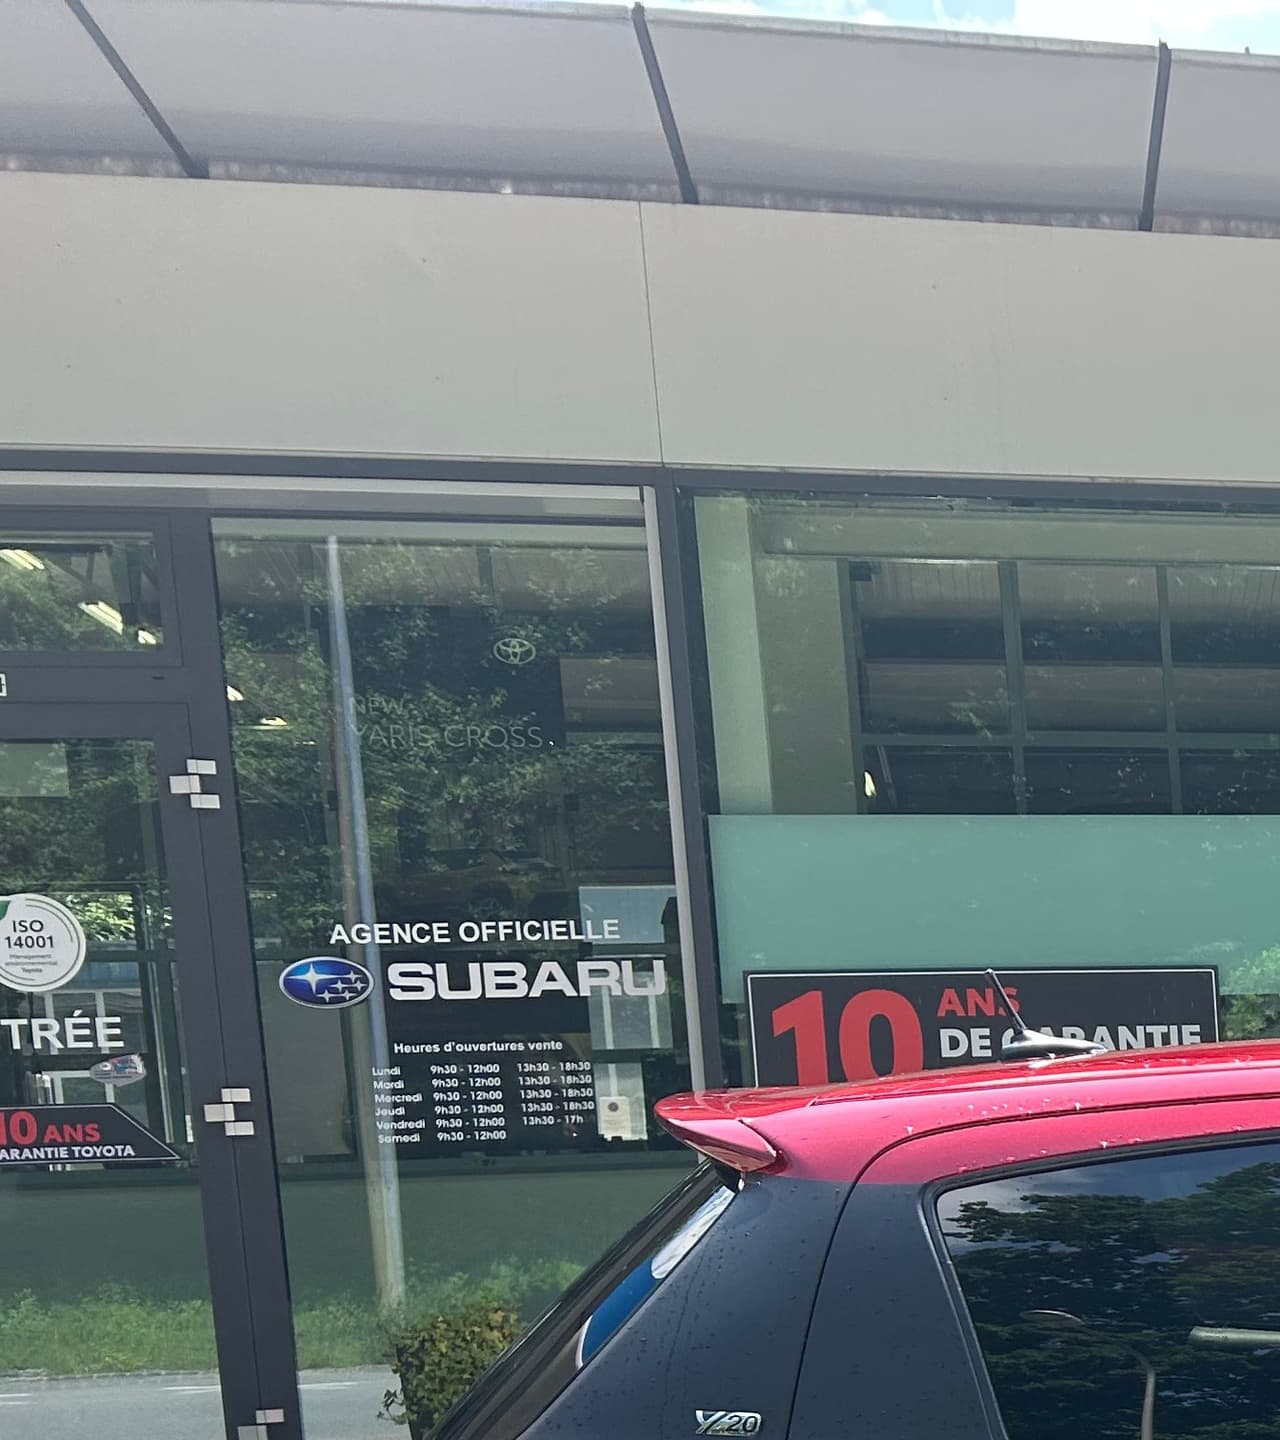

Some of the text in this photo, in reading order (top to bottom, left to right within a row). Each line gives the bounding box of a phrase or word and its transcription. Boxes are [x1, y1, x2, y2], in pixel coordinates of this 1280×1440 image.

[350, 723, 543, 748] YARIS CROSS
[12, 920, 44, 933] ISO
[329, 919, 621, 944] AGENCE OFFICIELLE
[5, 935, 54, 949] 14001
[387, 959, 666, 1000] SUBARU
[772, 989, 924, 1086] 10
[940, 1027, 992, 1058] DE
[394, 1041, 563, 1054] Heures d'ouvertures vente
[372, 1066, 400, 1076] Lundi
[430, 1064, 457, 1074] 9h30
[467, 1064, 500, 1073] 12h00
[517, 1063, 549, 1073] 13h30
[559, 1062, 591, 1071] 18h30
[373, 1079, 404, 1090] Mardi
[432, 1078, 458, 1088] 9h30
[468, 1077, 501, 1087] 12h00
[518, 1076, 550, 1085] 13h30
[560, 1075, 592, 1084] 18h30
[375, 1093, 422, 1103] Mercredi
[433, 1092, 460, 1101] 9h30
[470, 1090, 502, 1100] 12h00
[520, 1089, 552, 1099] 13h30
[562, 1088, 593, 1098] 18h30
[375, 1106, 405, 1116] Jeudi
[434, 1105, 461, 1115] 9h30
[471, 1104, 504, 1113] 12h00
[521, 1102, 553, 1112] 13h30
[563, 1101, 595, 1111] 18h30
[376, 1119, 425, 1130] Vendredi
[435, 1119, 462, 1128] 9h30
[473, 1117, 505, 1127] 12h00
[522, 1116, 554, 1125] 13h30
[564, 1115, 583, 1124] 17h
[43, 1123, 102, 1143] ANS
[378, 1133, 420, 1144] Samedi
[437, 1132, 464, 1141] 9h30
[474, 1131, 506, 1140] 12h00
[71, 1145, 135, 1158] TOYOTA
